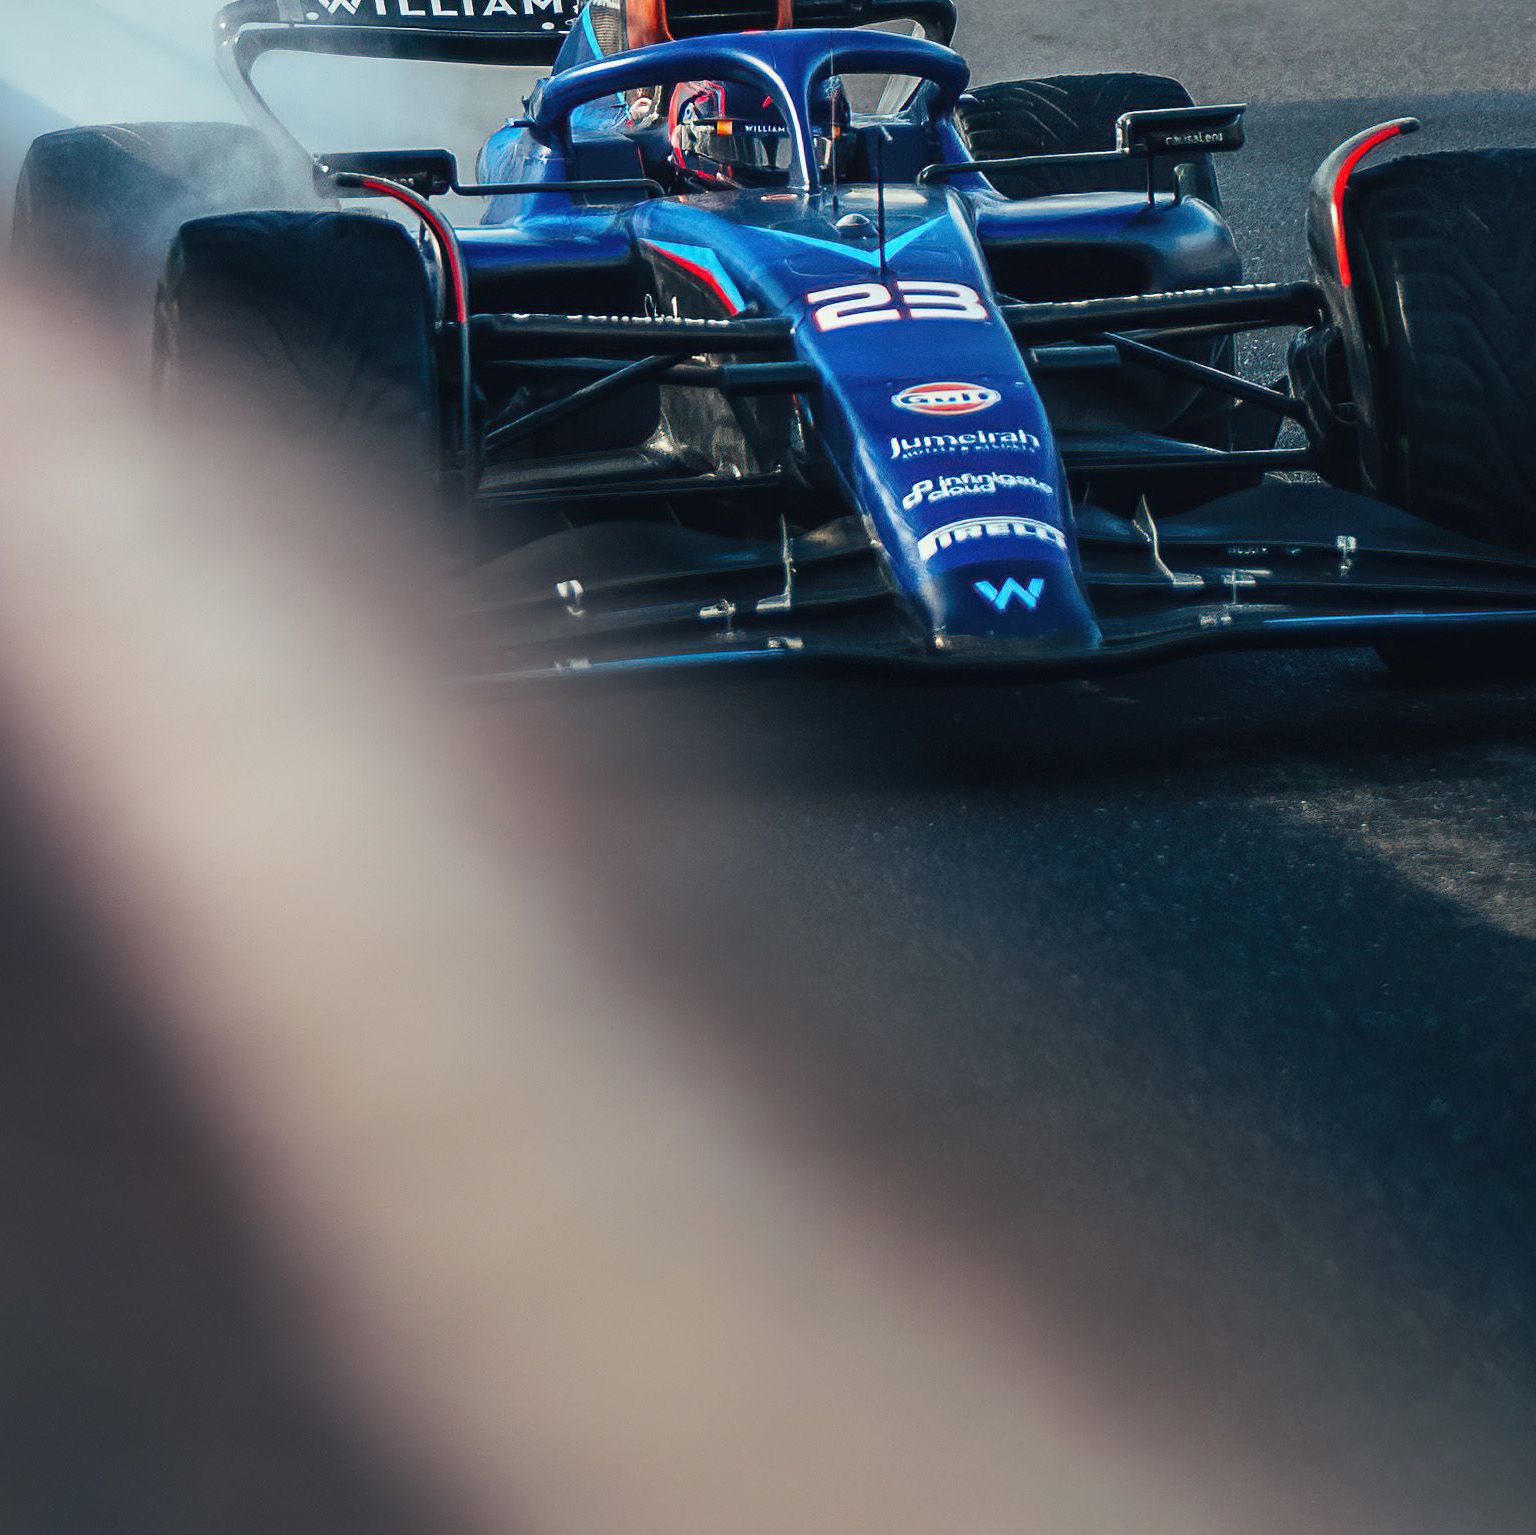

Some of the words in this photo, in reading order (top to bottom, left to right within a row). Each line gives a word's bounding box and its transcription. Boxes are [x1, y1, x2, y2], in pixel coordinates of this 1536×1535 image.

[744, 123, 786, 133] WILLIAM
[806, 280, 989, 332] 23
[890, 429, 1041, 460] Jumeirah
